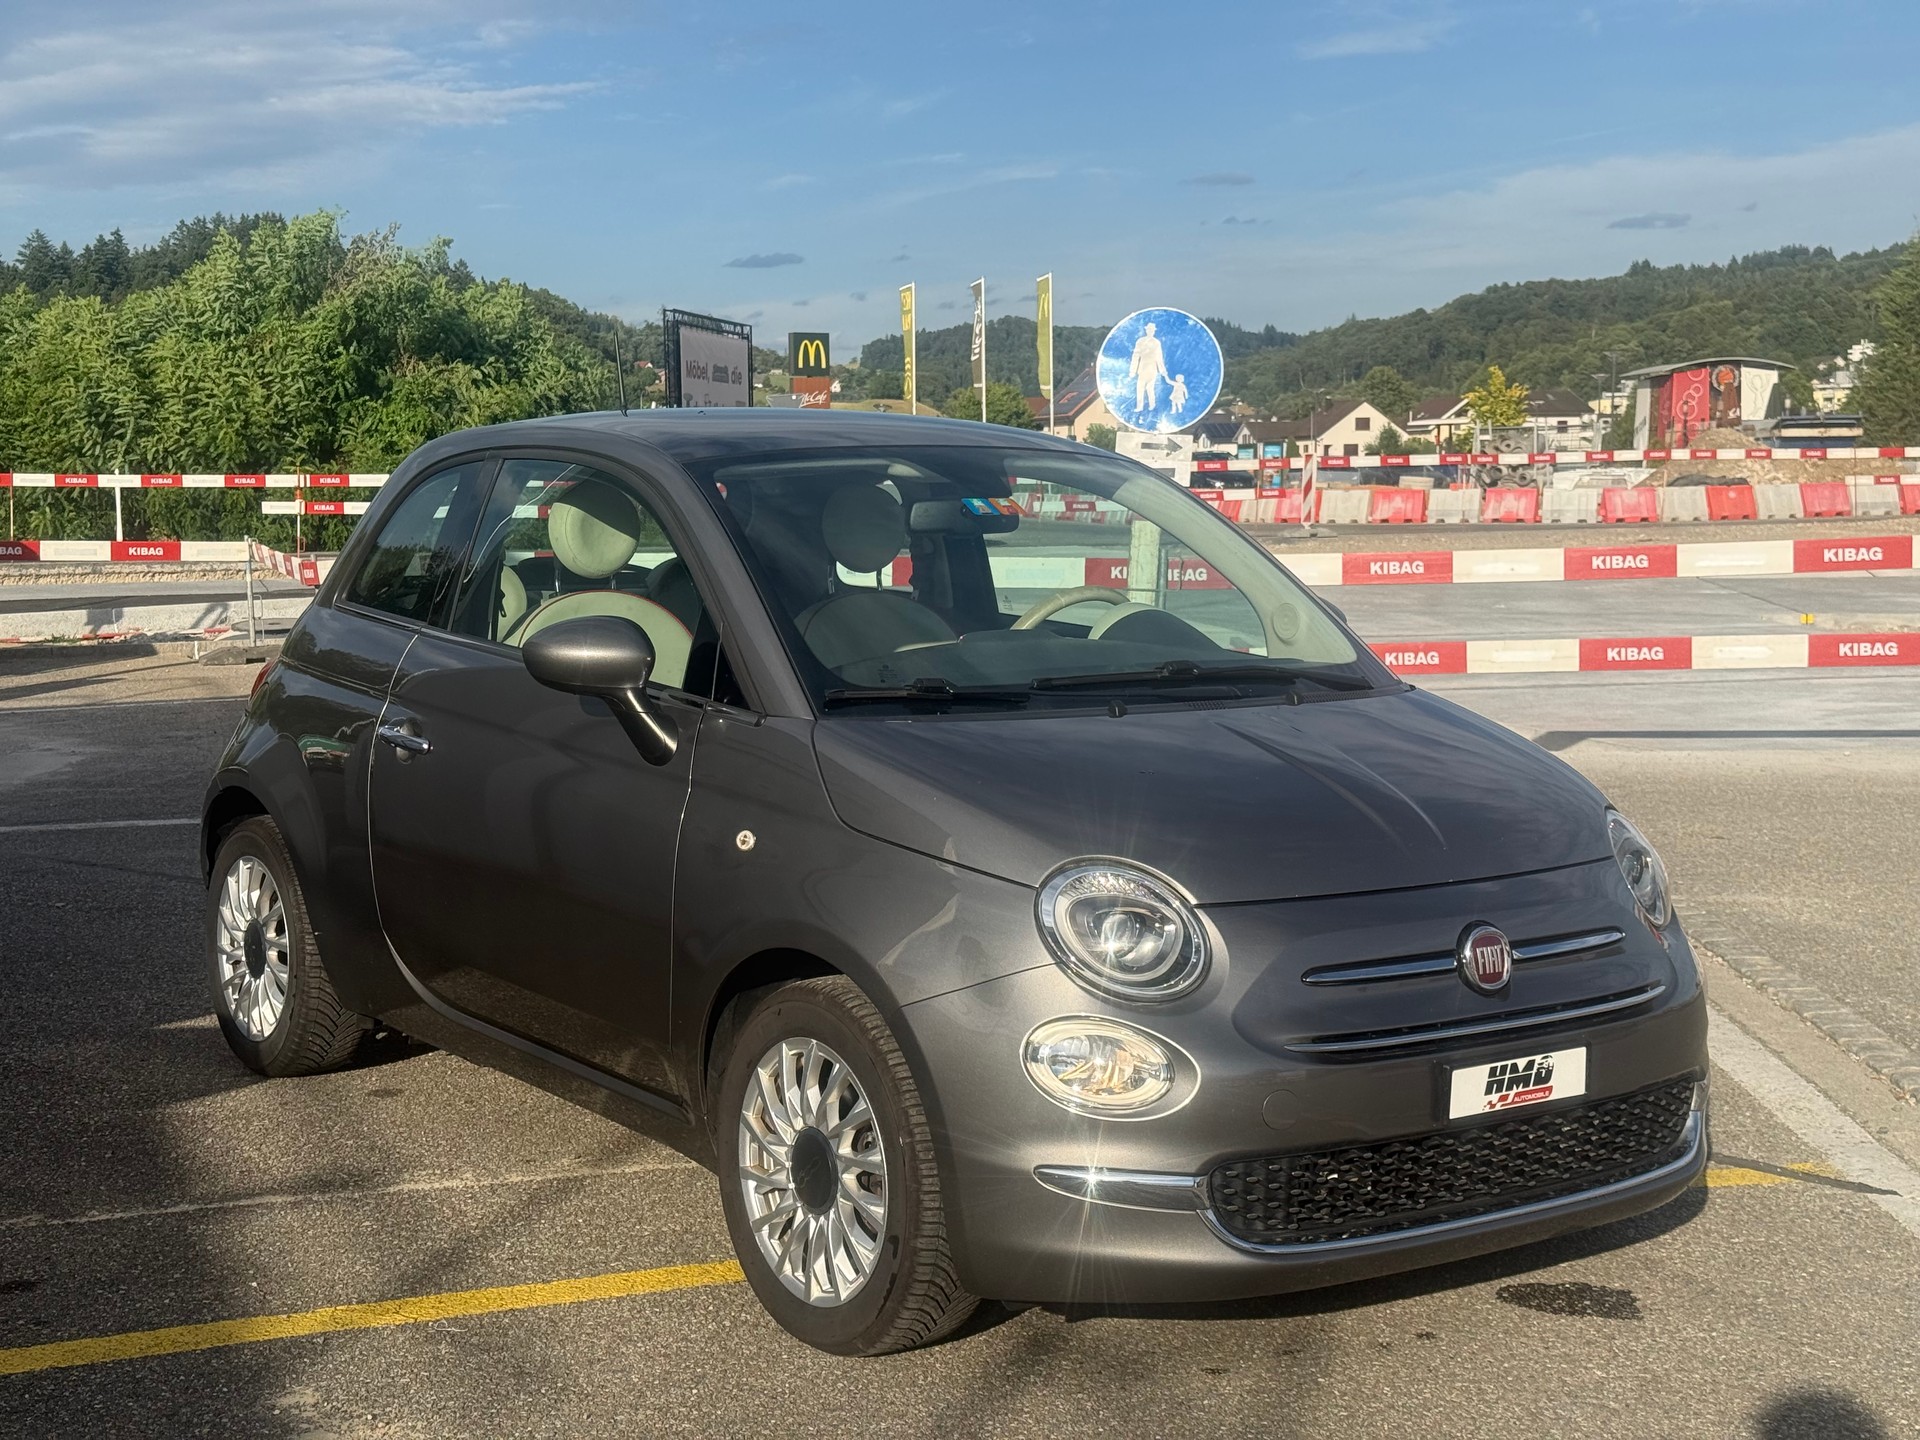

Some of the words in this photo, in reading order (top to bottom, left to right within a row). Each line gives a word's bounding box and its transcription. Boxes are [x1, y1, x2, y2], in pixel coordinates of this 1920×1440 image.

[685, 360, 710, 384] Möbel,
[730, 366, 742, 386] die
[128, 547, 164, 556] KIBAG
[1823, 547, 1884, 562] KIBAG
[1370, 560, 1424, 575] KIBAG
[1591, 555, 1649, 570] KIBAG
[1607, 646, 1664, 661] KIBAG
[1838, 642, 1898, 657] KIBAG
[1384, 651, 1440, 665] KIBAG
[1476, 944, 1503, 975] FIAT
[1513, 1090, 1550, 1102] AUTOMOBILE
